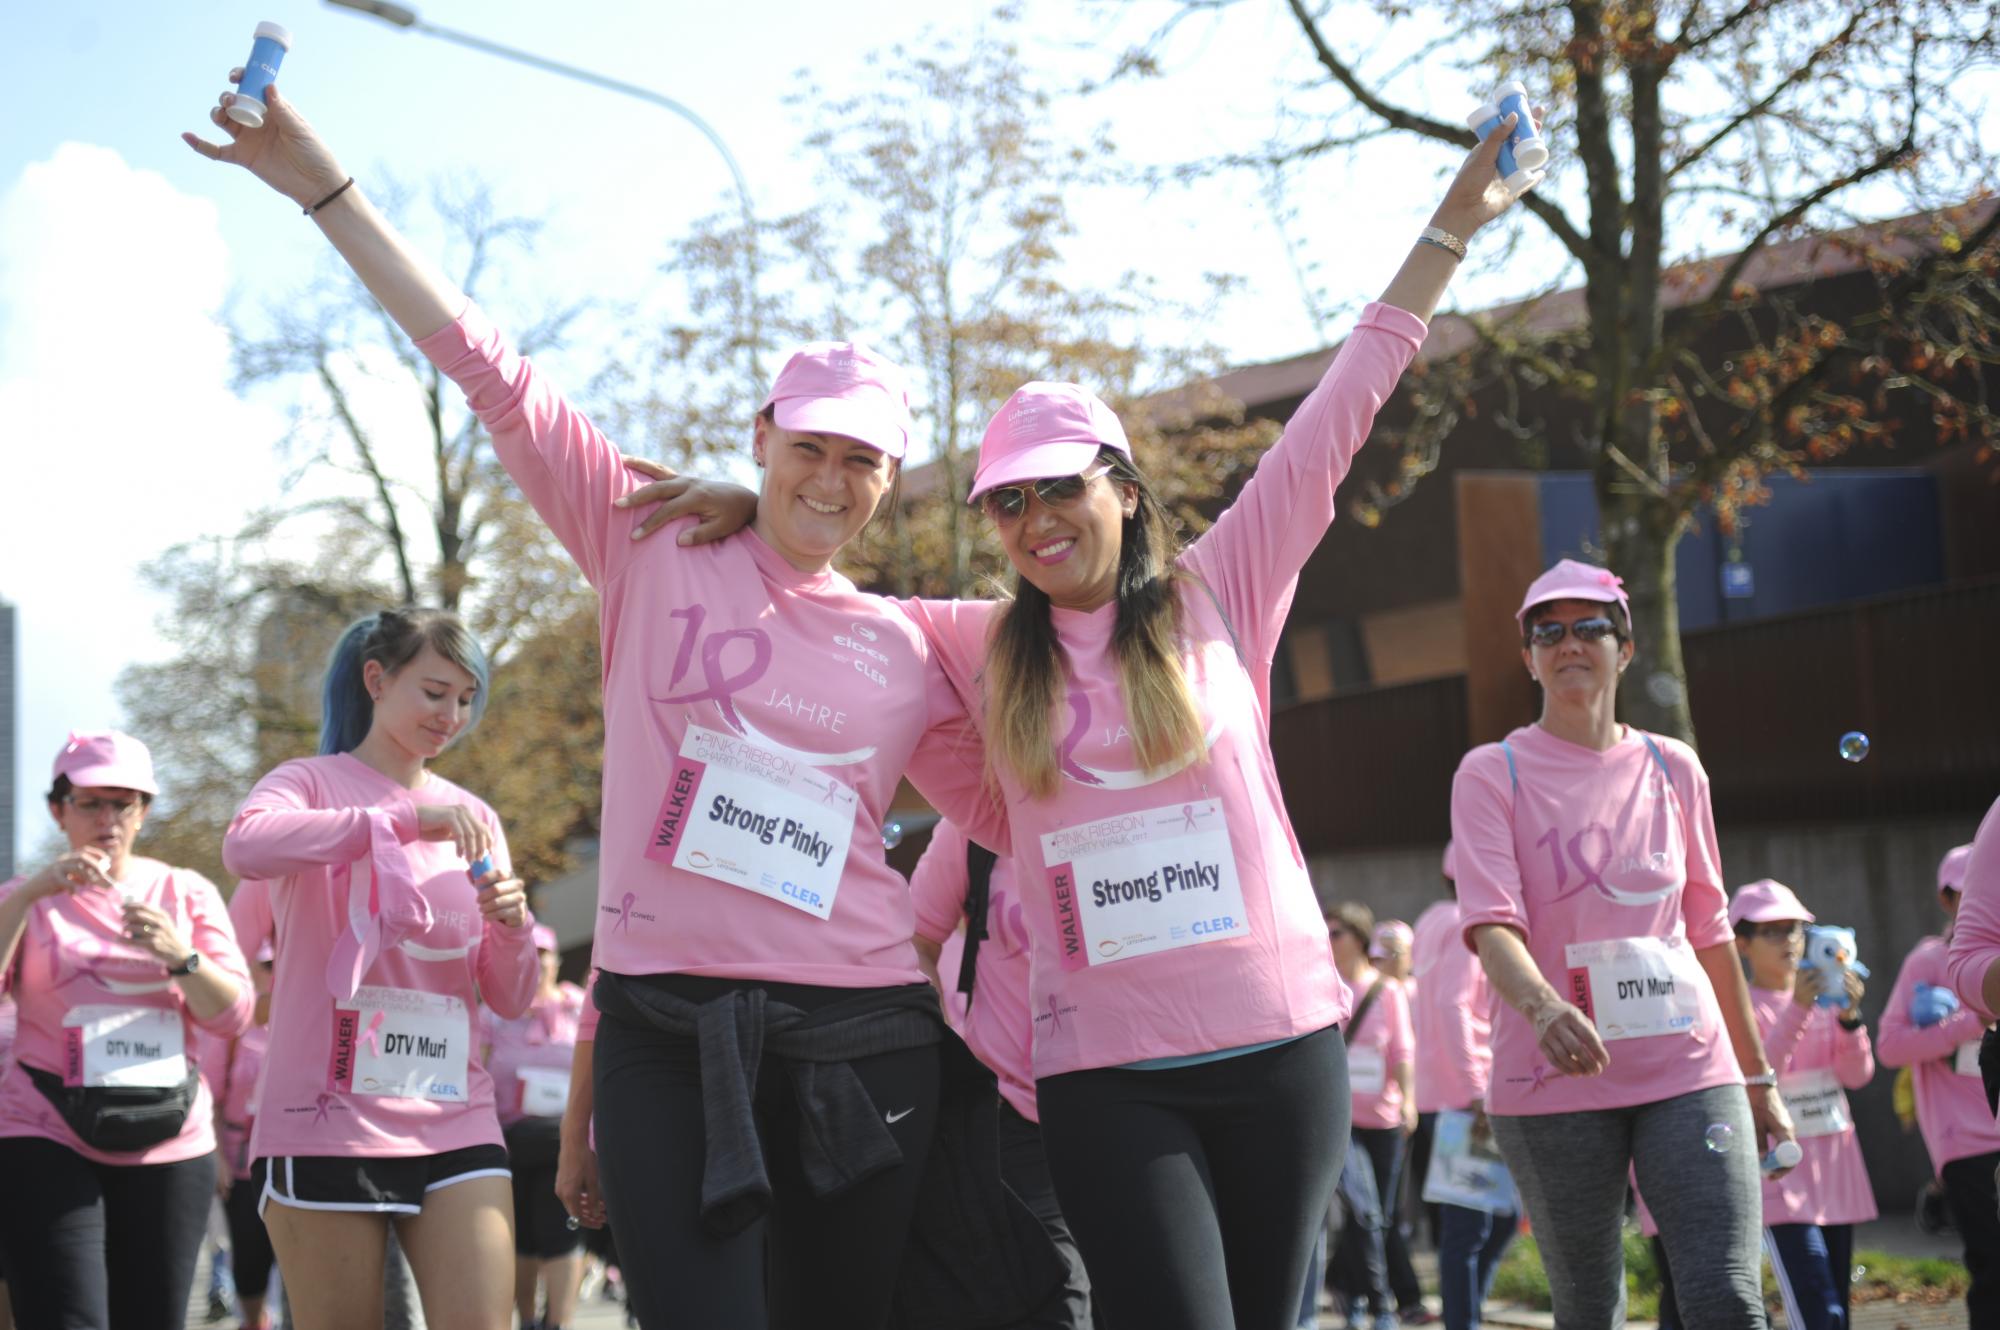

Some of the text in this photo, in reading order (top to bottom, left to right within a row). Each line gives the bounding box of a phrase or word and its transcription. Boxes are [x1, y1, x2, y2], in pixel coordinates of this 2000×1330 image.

[764, 687, 848, 735] JAHRE
[697, 748, 740, 769] CHARITY
[700, 732, 796, 776] PINK RIBBON
[655, 768, 696, 848] WALKER
[708, 794, 779, 846] Strong
[779, 817, 833, 868] Pinky
[1055, 815, 1145, 849] PINK RIBBON
[1092, 860, 1220, 908] Strong Pinky
[1054, 873, 1080, 956] WALKER
[1617, 975, 1675, 1000] DTV Muri
[106, 1040, 130, 1056] DTV
[334, 1016, 353, 1081] WALKER
[385, 1032, 447, 1059] DTV Muri
